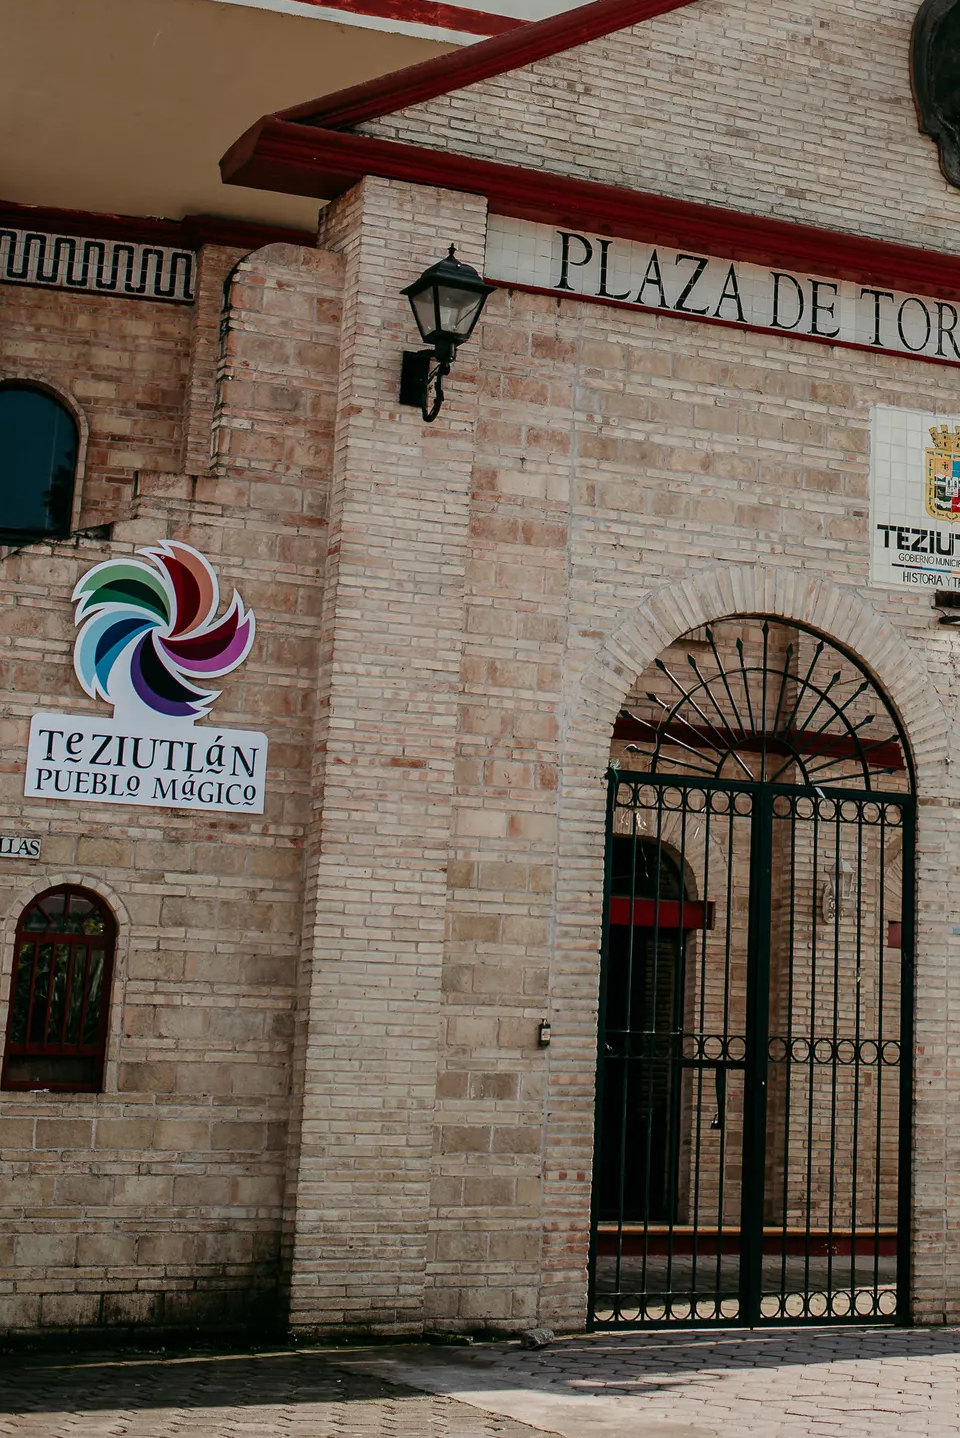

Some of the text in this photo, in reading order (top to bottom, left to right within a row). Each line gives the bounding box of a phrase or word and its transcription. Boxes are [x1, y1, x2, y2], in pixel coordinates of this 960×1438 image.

[554, 230, 748, 323] PLAZA
[769, 271, 840, 338] DE
[898, 552, 935, 565] GOBIERNO
[902, 571, 944, 586] HISTORIA
[945, 576, 952, 587] Y
